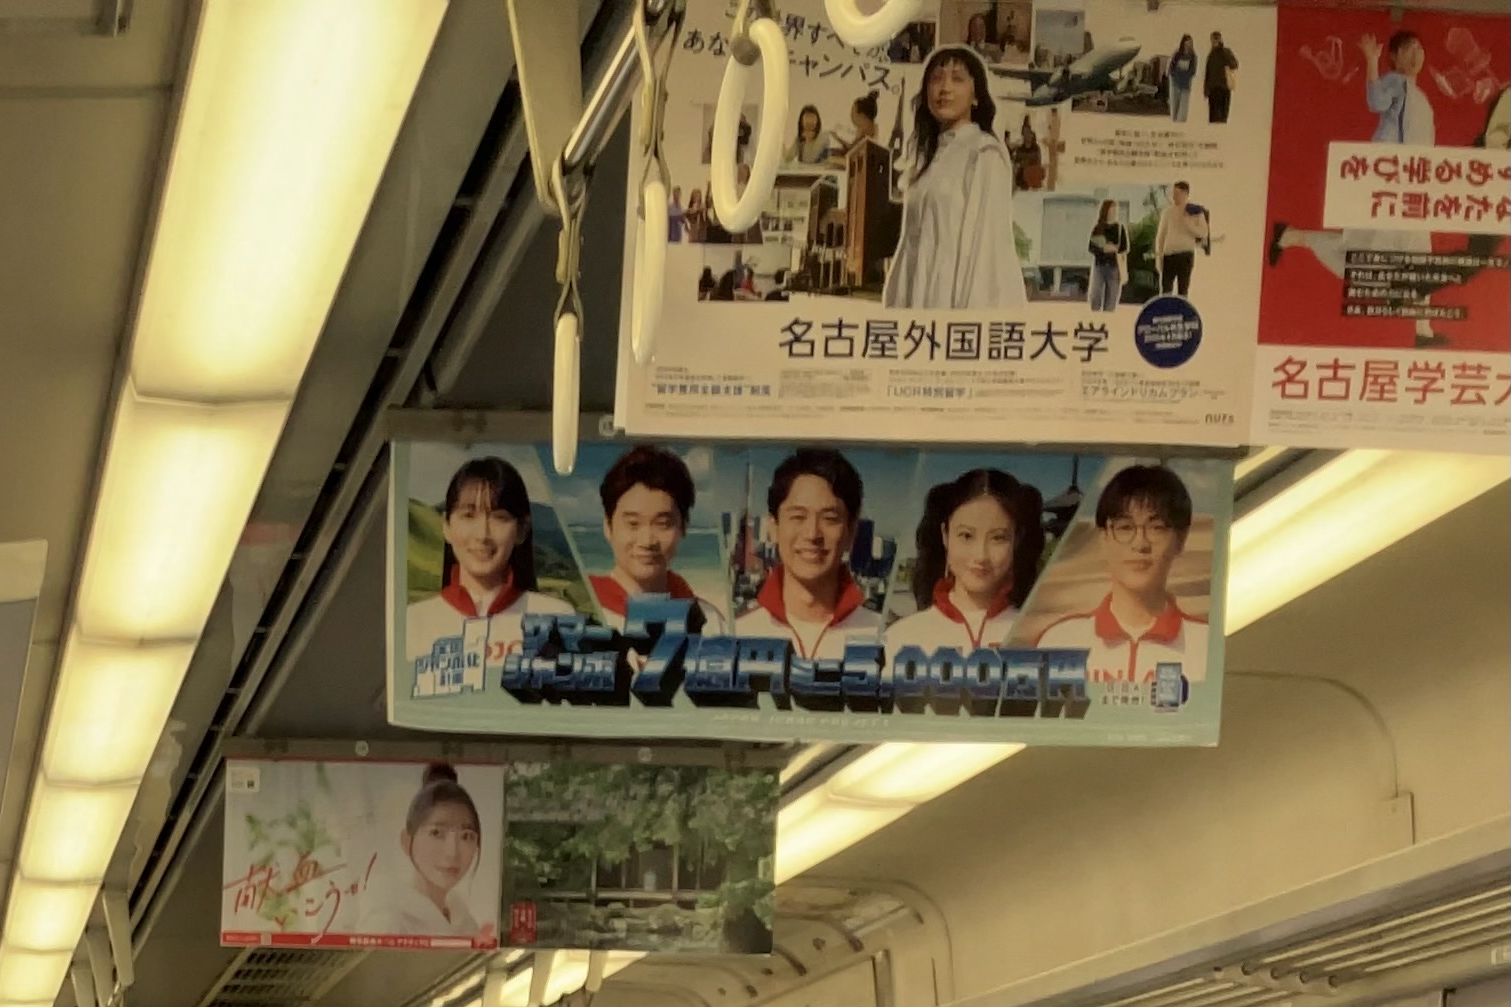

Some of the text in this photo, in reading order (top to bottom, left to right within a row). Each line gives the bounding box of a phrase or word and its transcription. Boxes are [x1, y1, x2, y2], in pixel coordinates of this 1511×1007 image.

[778, 315, 1110, 364] 名古屋外国語大学
